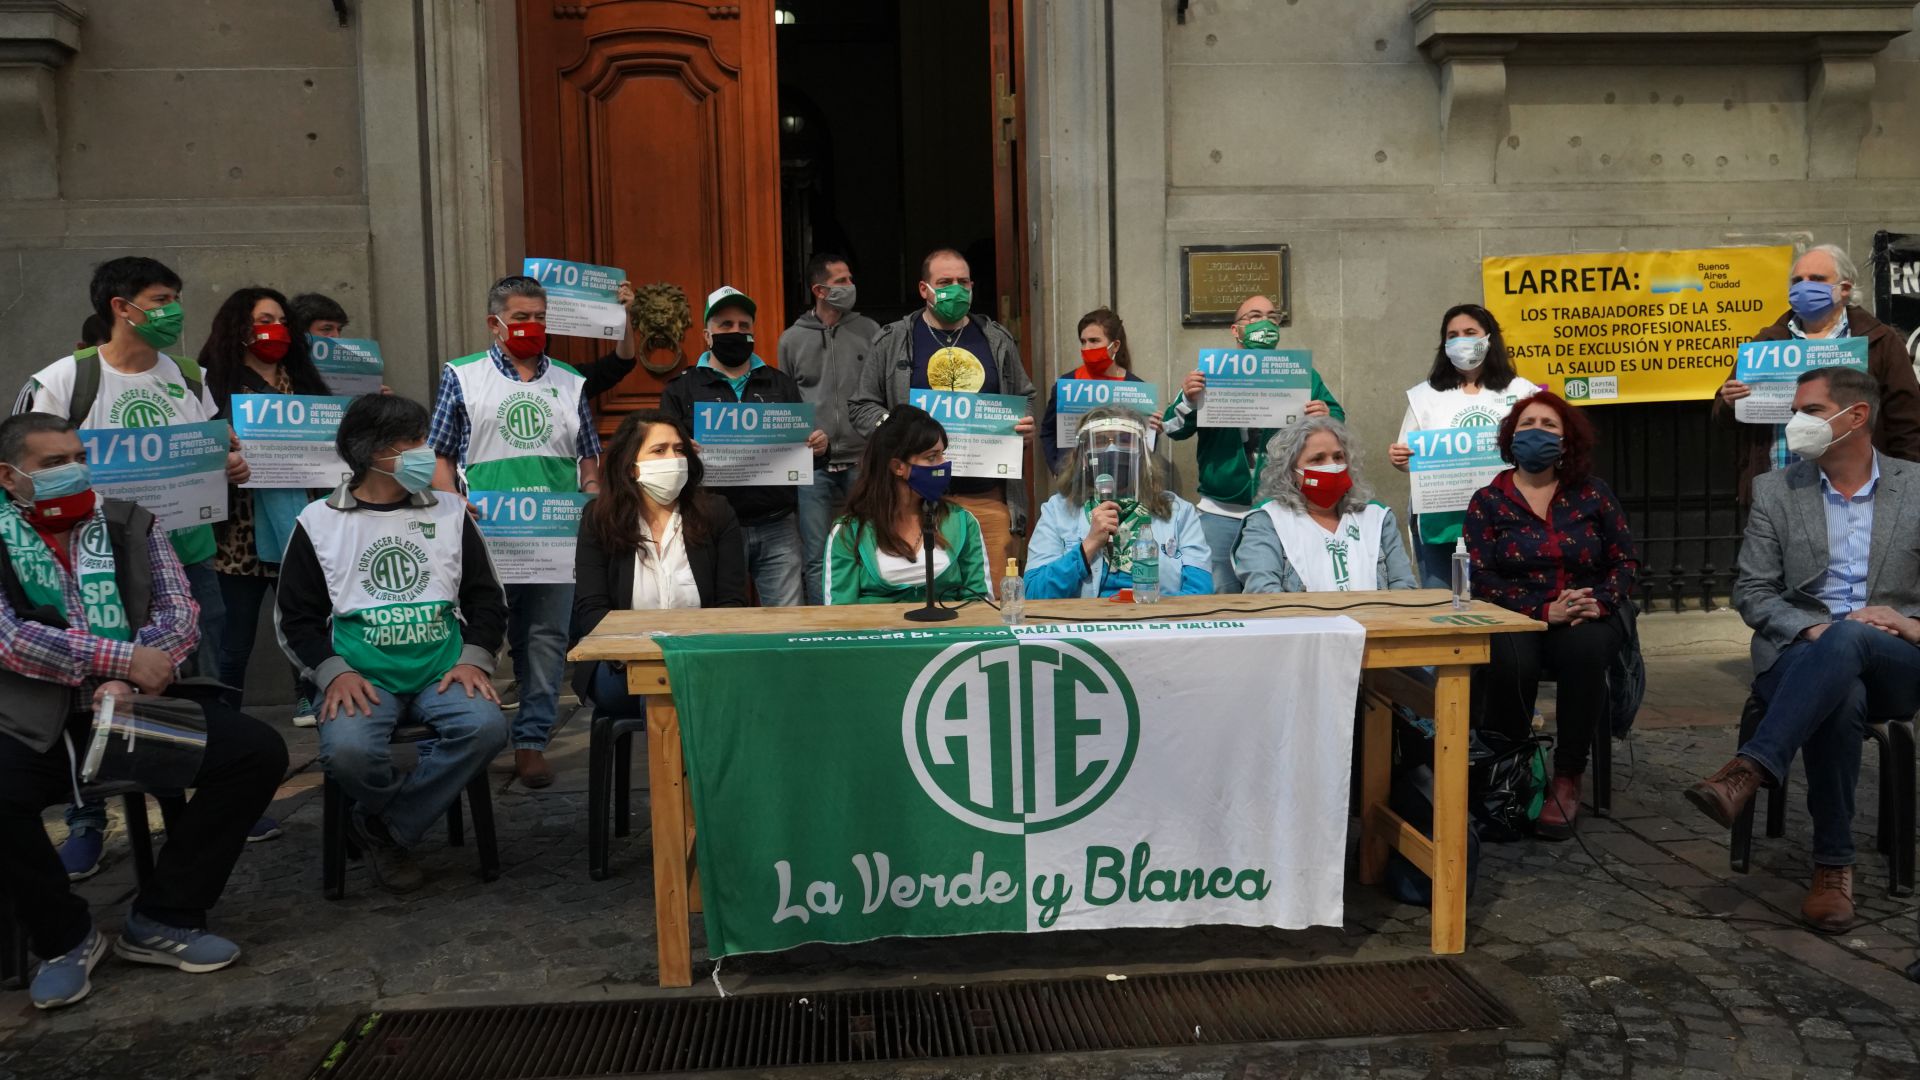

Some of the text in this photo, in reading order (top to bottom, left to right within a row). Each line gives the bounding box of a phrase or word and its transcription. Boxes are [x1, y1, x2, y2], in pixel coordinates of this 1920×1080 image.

[529, 262, 578, 286] 1/10
[583, 270, 608, 278] JORNADA
[1698, 263, 1730, 272] Buenos
[1704, 272, 1727, 280] Aires
[590, 276, 617, 284] PROTESTA
[590, 282, 607, 290] SALUD
[1504, 267, 1640, 295] LARRETA:
[1709, 280, 1740, 289] Ciudad
[1521, 300, 1764, 322] LOS TRABAJADORES DE LA SALUD
[1554, 319, 1732, 338] SOMOS PROFESIONALES.
[1507, 344, 1550, 358] BASTA
[1556, 344, 1574, 356] DE
[1580, 338, 1659, 356] EXCLUSIÓN
[1664, 341, 1672, 352] Y
[1744, 344, 1802, 369] 1/10
[1204, 353, 1258, 375] 1/10
[1548, 354, 1734, 375] LA SALUD ES UN DERECHO
[1062, 383, 1110, 403] 1/10
[1772, 392, 1794, 400] reprim
[110, 388, 140, 424] FORTALECER
[142, 389, 150, 400] EL
[152, 393, 176, 418] ESTADO
[240, 399, 305, 425] 1/10
[497, 392, 526, 419] FORTALECER
[528, 392, 534, 400] EL
[535, 396, 553, 418] ESTADO
[916, 394, 971, 419] 1/10
[510, 404, 540, 436] ATE
[700, 407, 758, 431] 1/10
[169, 438, 216, 450] DE PROTESTA
[170, 431, 203, 441] JORNADA
[498, 426, 509, 442] PARA
[509, 439, 535, 450] LIBERAR
[535, 440, 542, 448] LA
[1414, 432, 1472, 457] 1/10
[84, 433, 163, 465] 1/10
[181, 447, 204, 457] SALUD
[476, 496, 537, 521] 1/10
[359, 536, 428, 572] FORTALECER EL ESTADO
[376, 554, 413, 588] ATE
[361, 570, 431, 602] PARA LIBERAR LA NACION
[362, 604, 442, 625] HOSPITA
[363, 620, 450, 646] ZUBIZARRETA
[788, 632, 904, 642] FORTALECER
[1014, 625, 1060, 636] PARA
[926, 645, 1110, 814] ATE
[772, 842, 1272, 928] La Verde y Blanca
